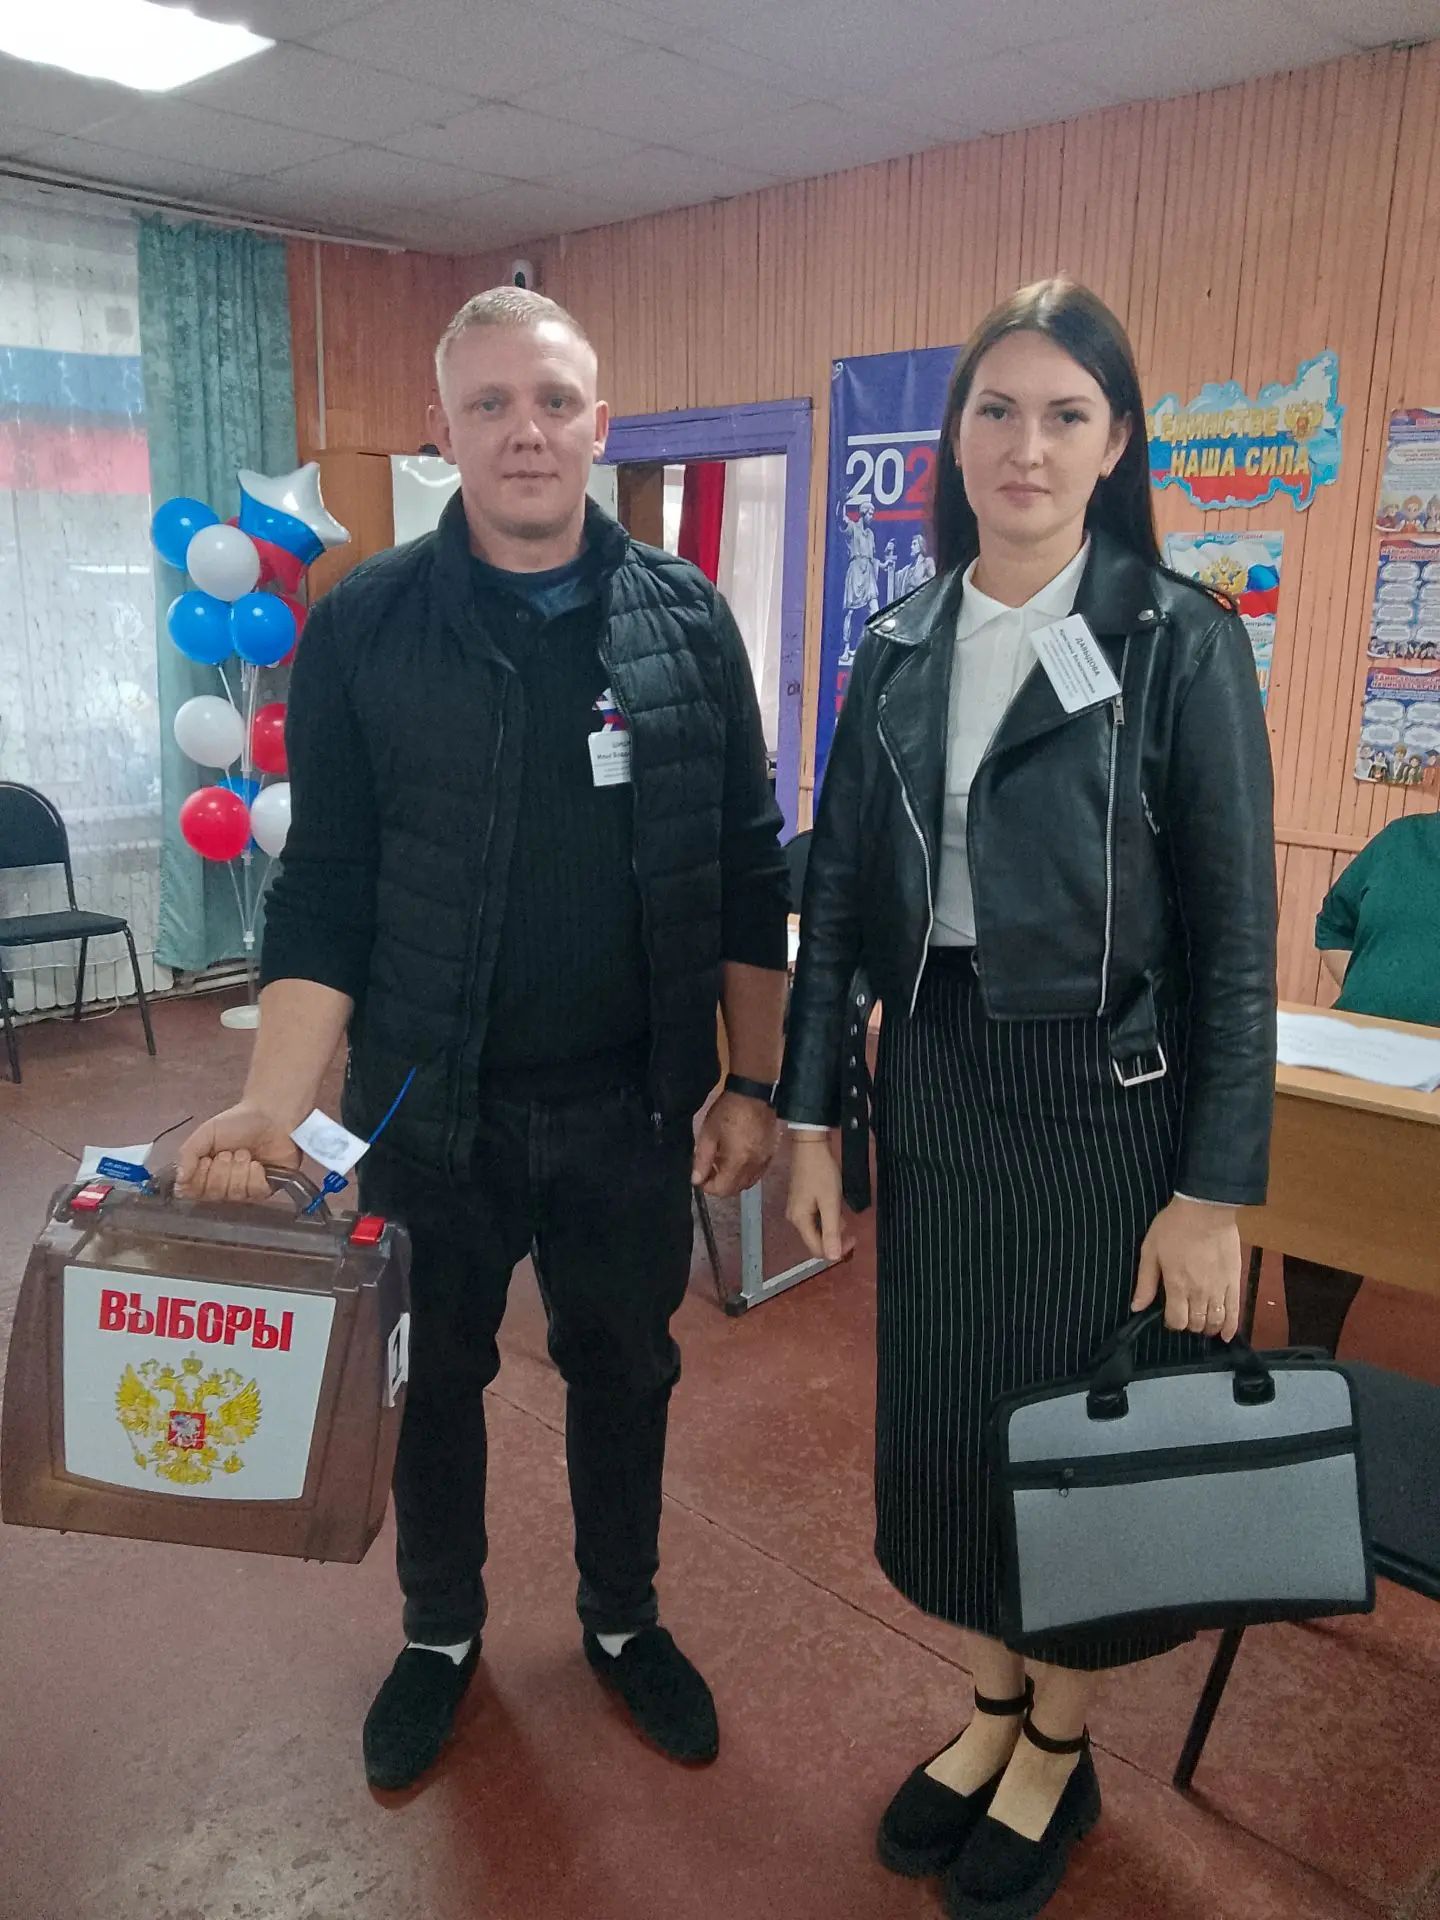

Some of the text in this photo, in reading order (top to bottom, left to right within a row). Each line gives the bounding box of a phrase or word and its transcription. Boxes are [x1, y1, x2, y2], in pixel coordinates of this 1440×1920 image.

[1160, 408, 1279, 447] ЕДИНСТВЕ
[1171, 446, 1310, 477] НАША СИЛА
[97, 1289, 295, 1352] ВЫБОРЫ
